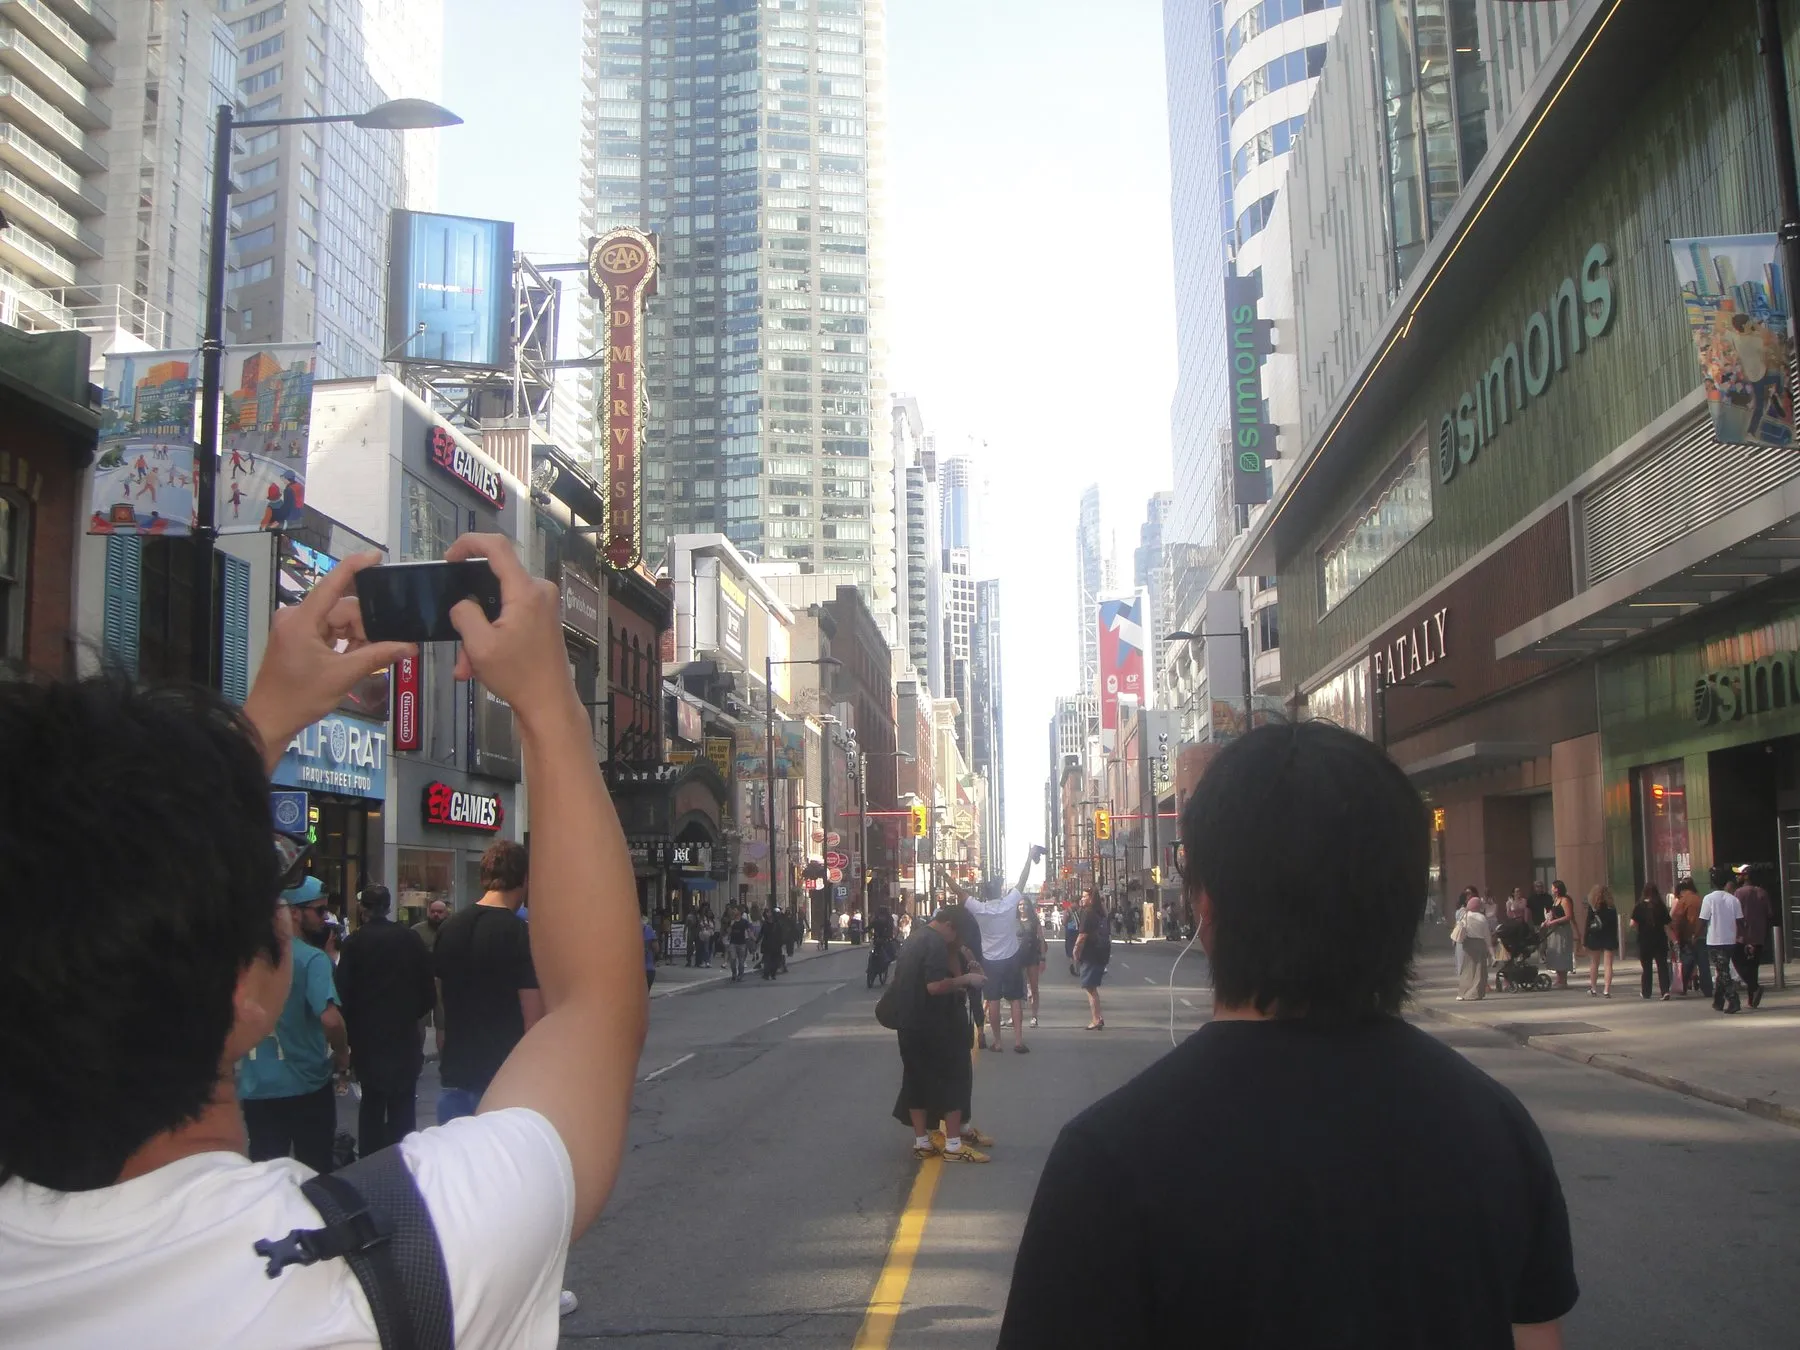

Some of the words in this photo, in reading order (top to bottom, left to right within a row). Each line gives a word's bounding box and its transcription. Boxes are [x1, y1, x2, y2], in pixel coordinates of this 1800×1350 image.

[605, 247, 638, 271] CAA
[428, 284, 460, 292] NEVER
[612, 284, 631, 328] ED
[1232, 304, 1260, 448] simons
[1457, 242, 1612, 464] simons
[611, 344, 632, 527] MIRVISH
[453, 446, 498, 500] GAMES
[1374, 607, 1447, 683] EATALY
[1716, 650, 1800, 722] sim
[402, 695, 411, 738] Nintendo
[325, 769, 352, 787] STREET
[354, 776, 371, 791] FOOD
[450, 791, 497, 826] GAMES
